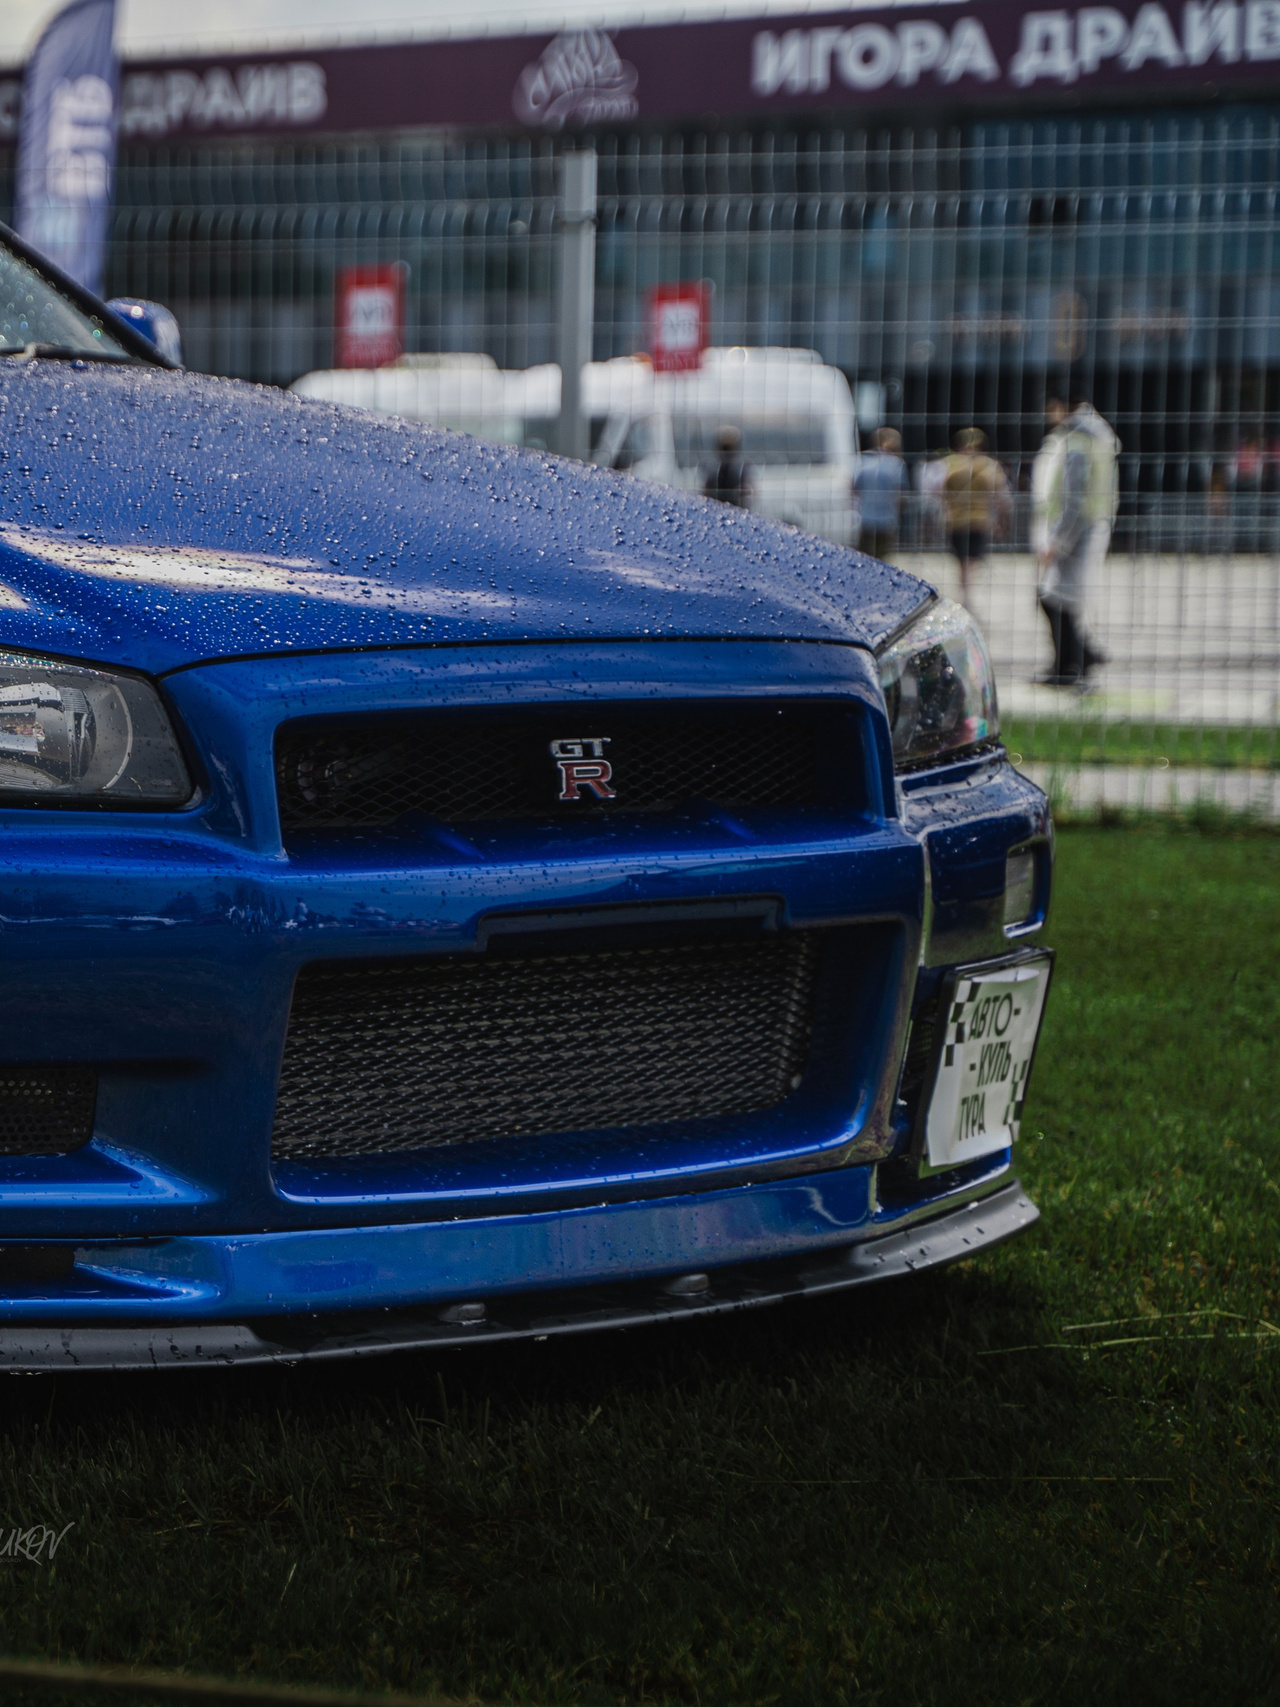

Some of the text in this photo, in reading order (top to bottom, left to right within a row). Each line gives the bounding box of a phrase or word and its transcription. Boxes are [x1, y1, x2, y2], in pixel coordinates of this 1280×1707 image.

[751, 18, 1000, 95] ИГОРА
[550, 737, 612, 758] GT
[557, 759, 617, 800] R
